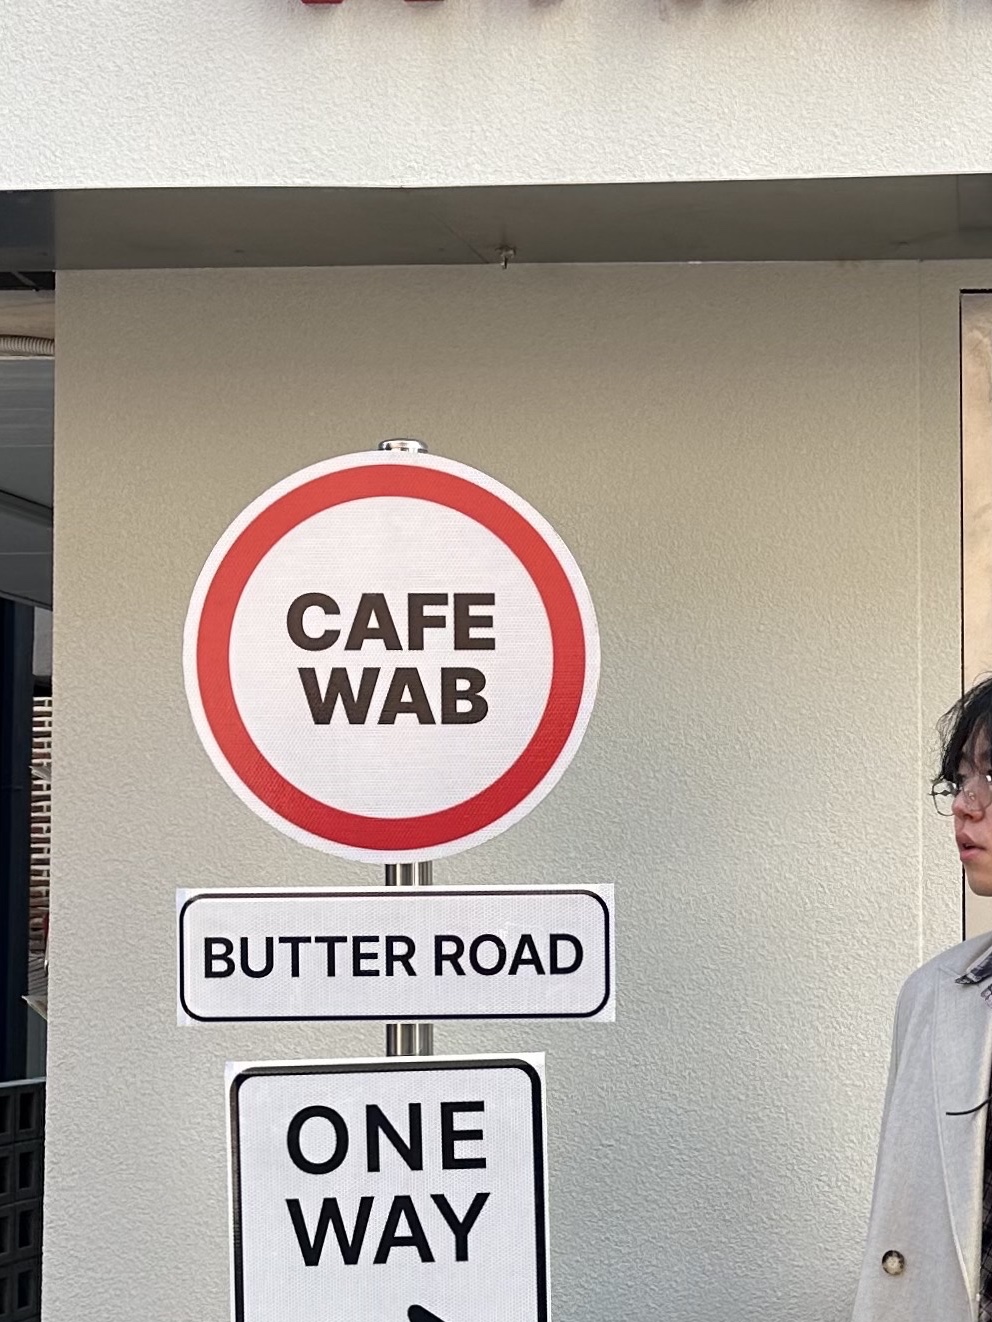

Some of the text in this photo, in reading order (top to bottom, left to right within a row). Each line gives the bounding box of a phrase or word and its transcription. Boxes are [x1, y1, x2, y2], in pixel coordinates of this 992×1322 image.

[286, 592, 496, 652] CAFE
[298, 667, 489, 725] WAB
[204, 933, 584, 979] BUTTER ROAD
[286, 1100, 487, 1175] ONE
[285, 1192, 490, 1267] WAY
